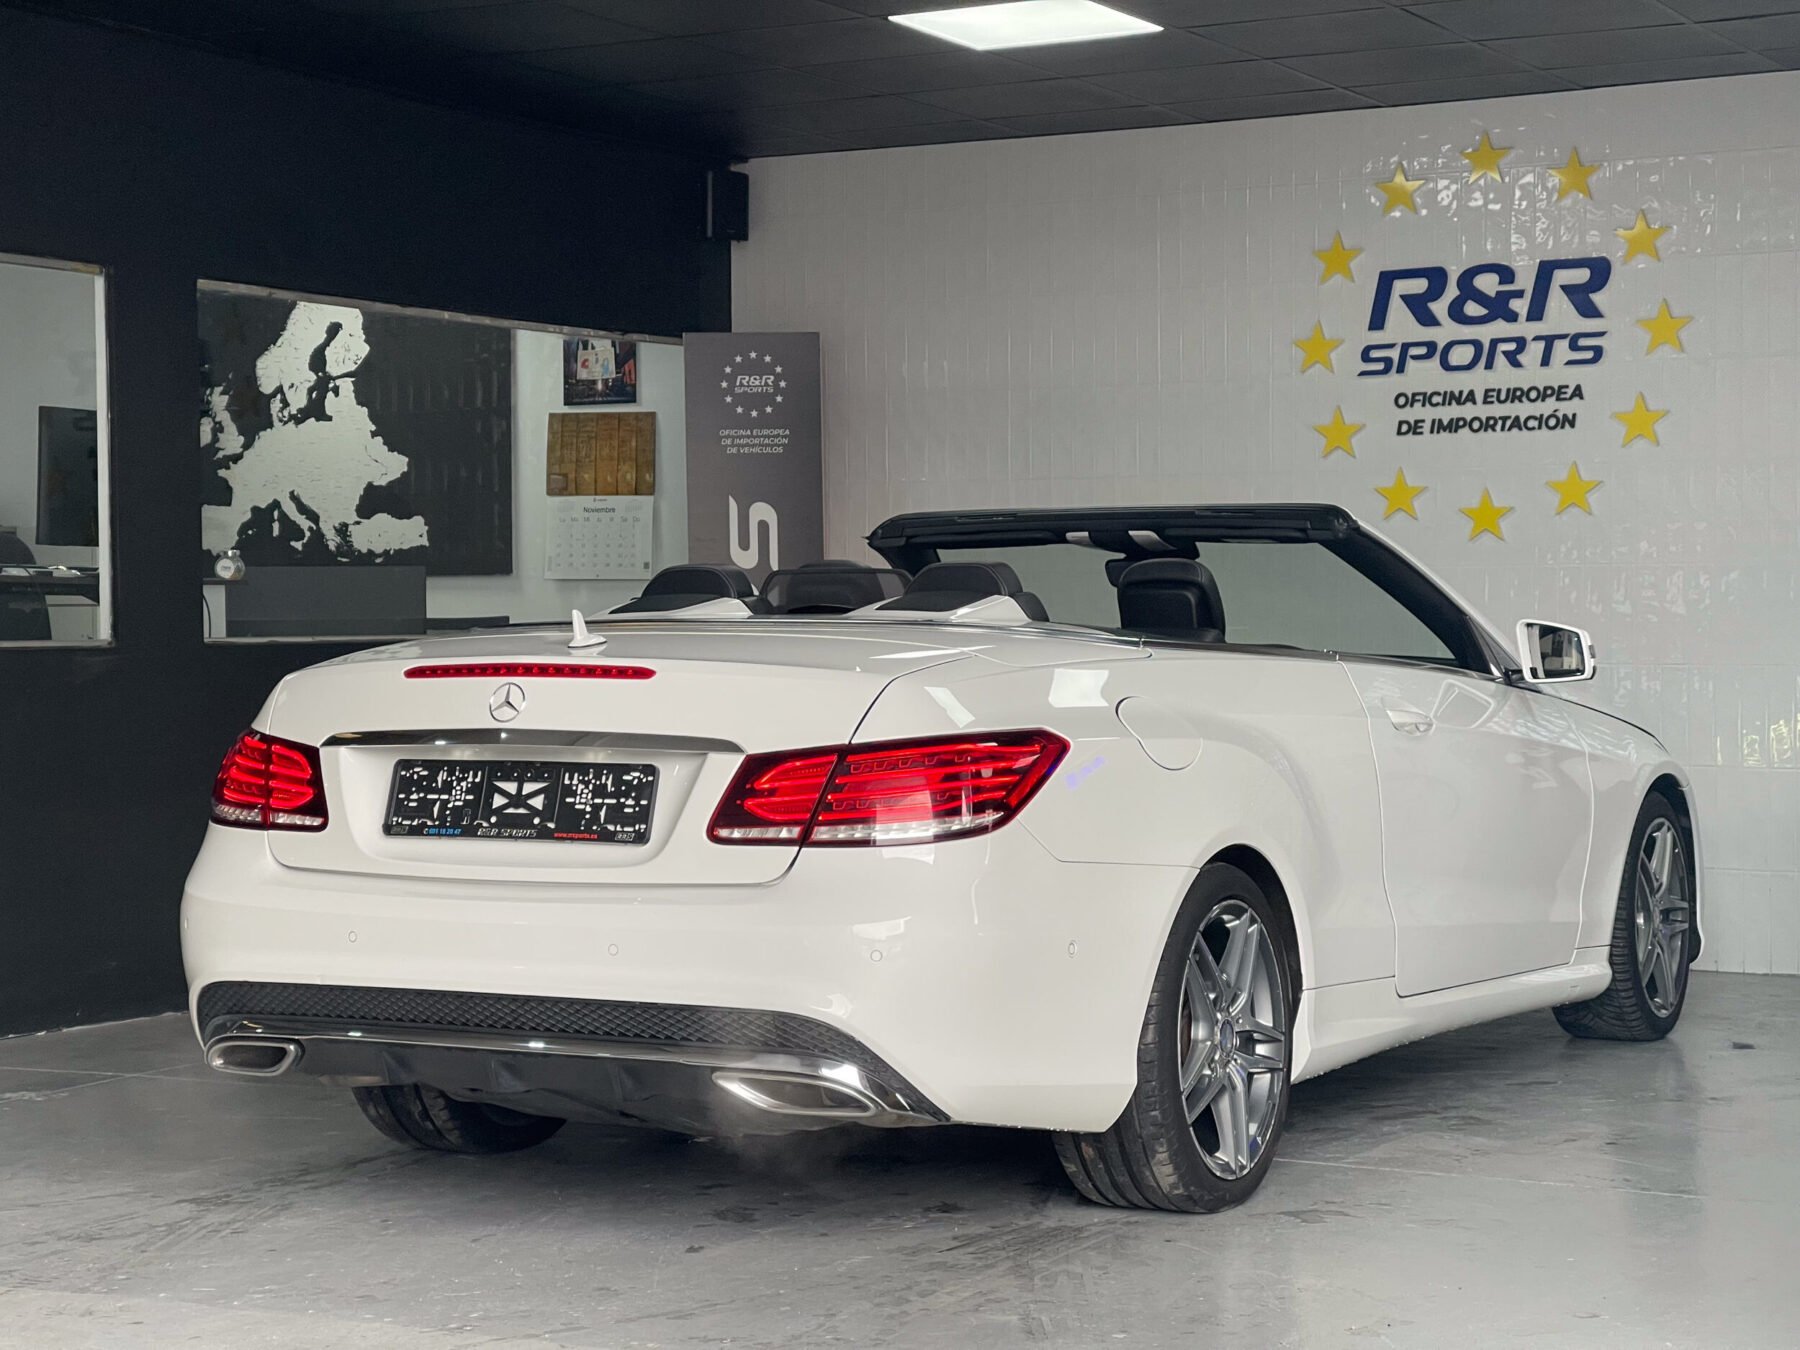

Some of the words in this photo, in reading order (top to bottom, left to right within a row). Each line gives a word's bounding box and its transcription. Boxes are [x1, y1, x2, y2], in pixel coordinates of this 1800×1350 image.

[1367, 255, 1613, 332] R&R
[1356, 330, 1609, 377] SPORTS
[735, 375, 775, 386] R&R
[734, 386, 774, 394] SPORTS
[1393, 388, 1478, 409] OFICINA
[1482, 383, 1585, 406] EUROPEA
[1396, 419, 1426, 436] DE
[1429, 409, 1577, 435] IMPORTACIÓN
[753, 428, 790, 436] EUROPEA
[734, 436, 789, 445] IMPORTACIÓN
[739, 445, 784, 454] VEHÍCULOS
[499, 828, 538, 838] SPORTS
